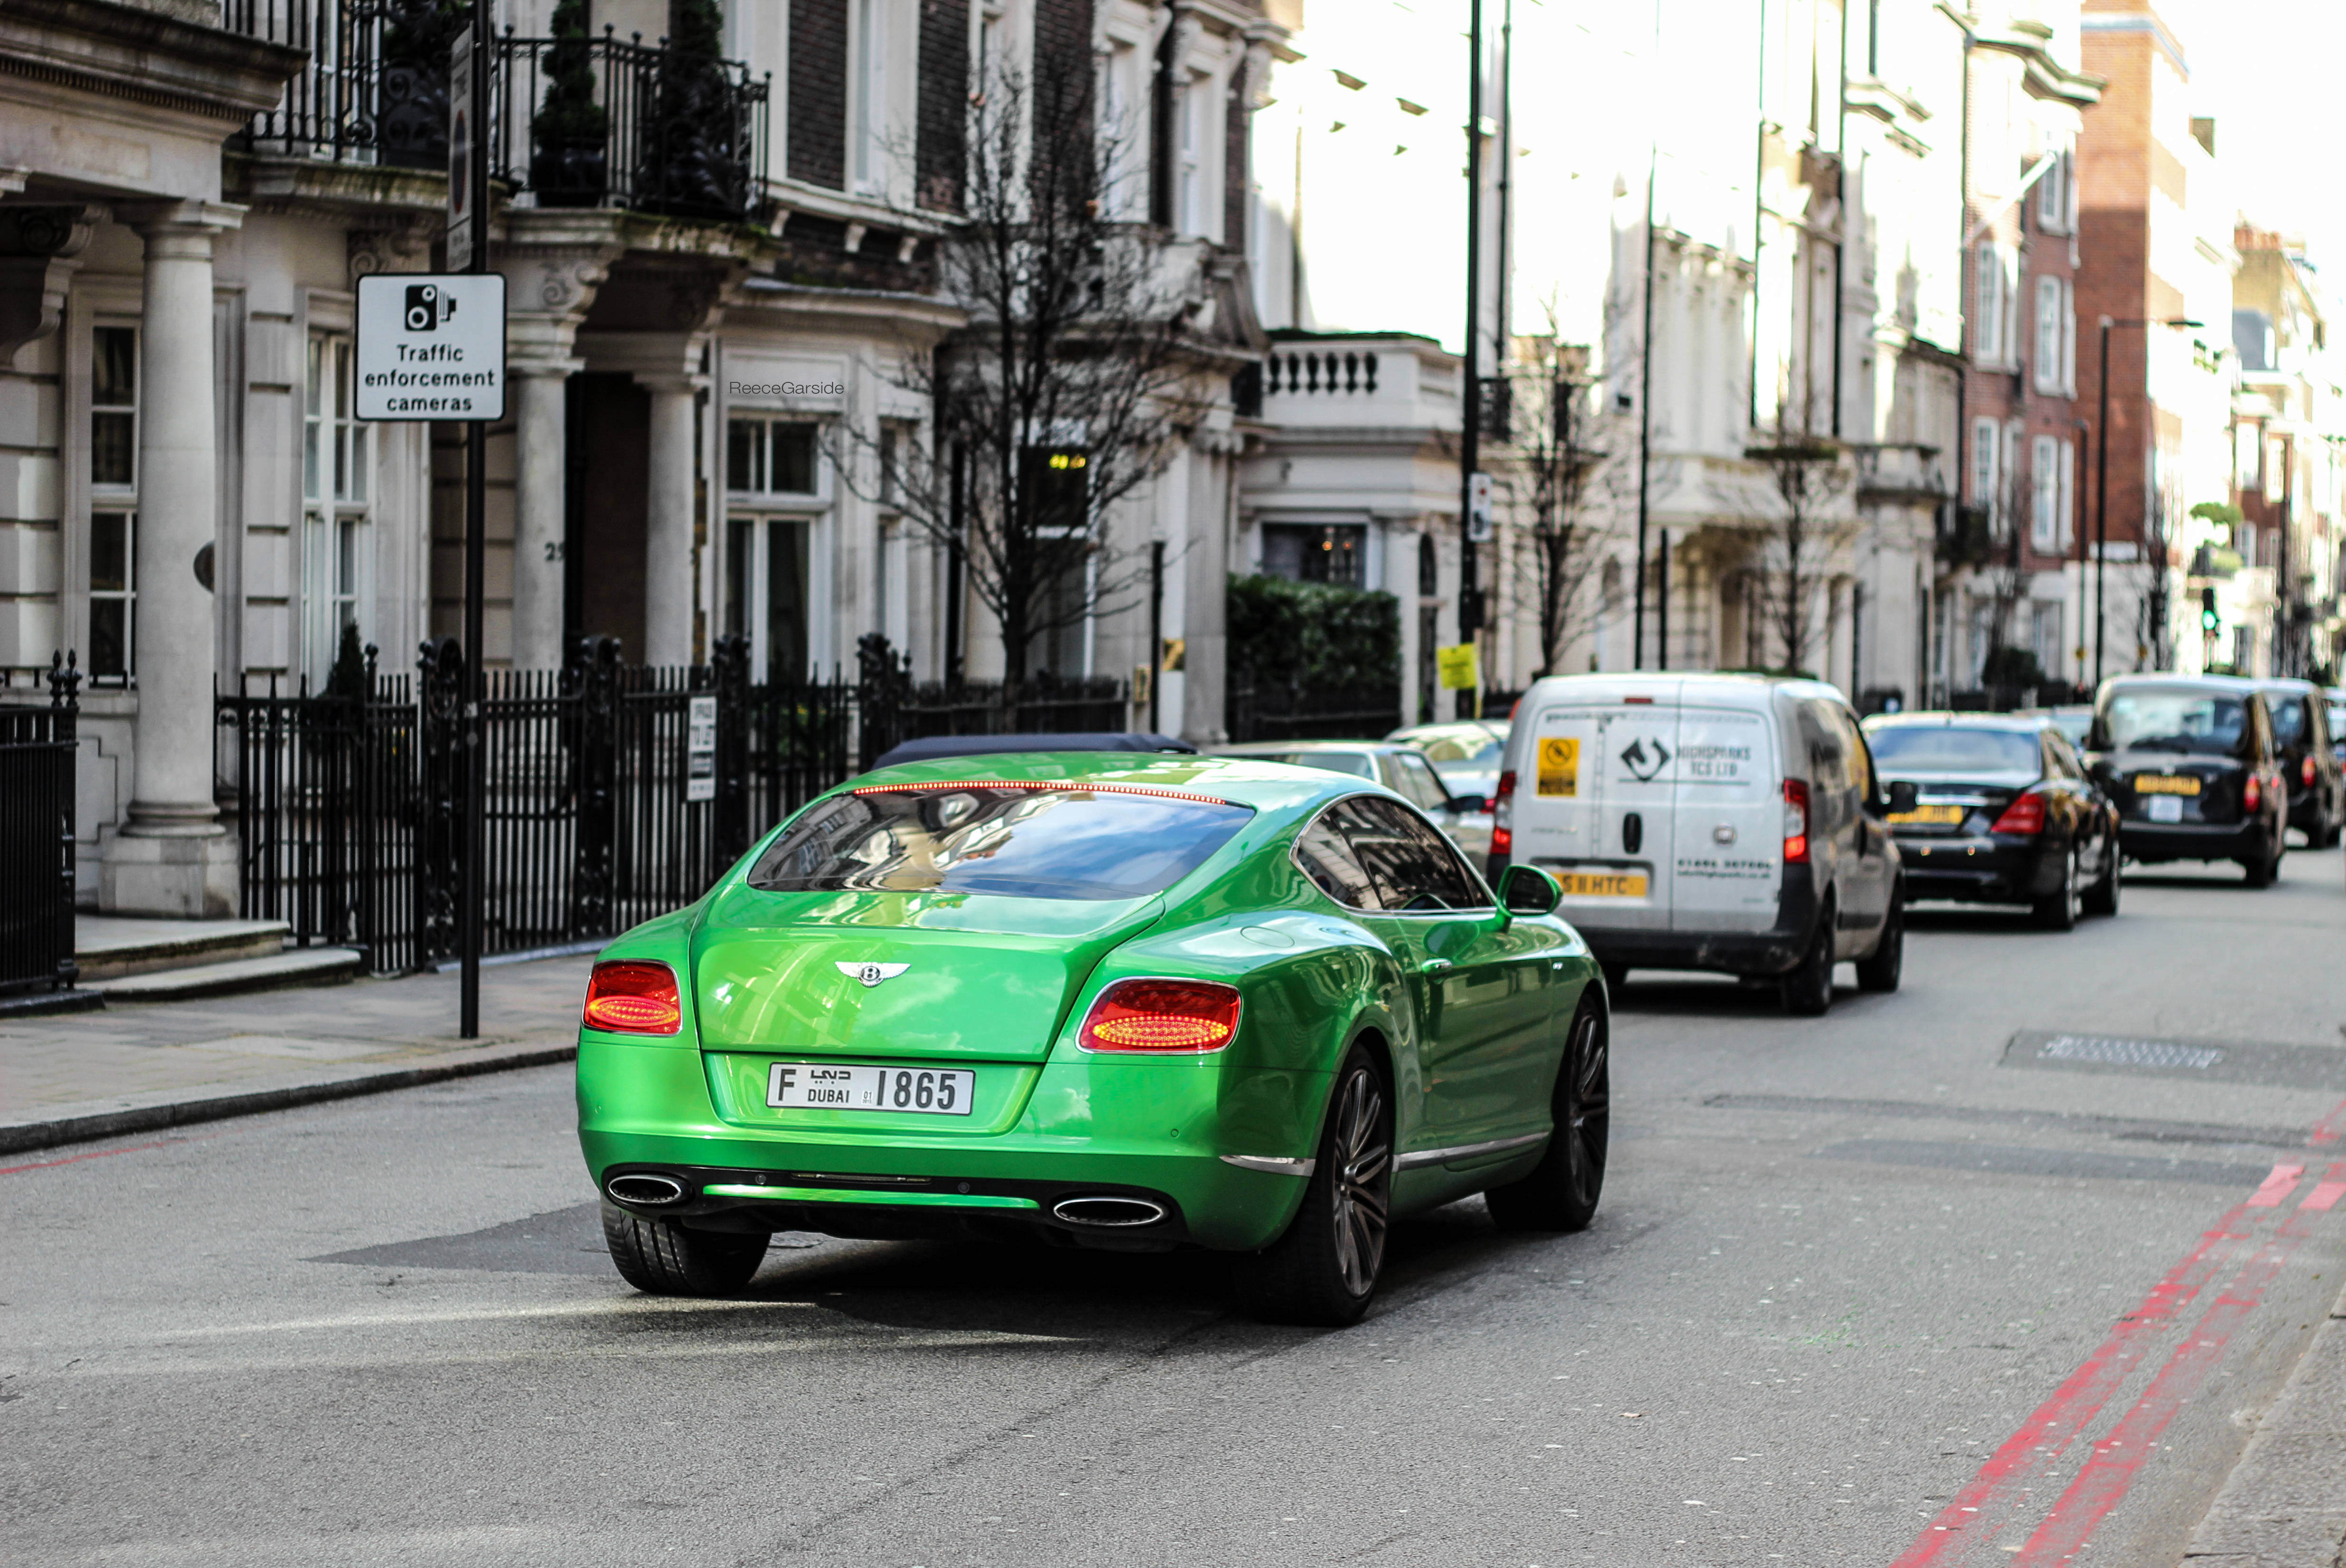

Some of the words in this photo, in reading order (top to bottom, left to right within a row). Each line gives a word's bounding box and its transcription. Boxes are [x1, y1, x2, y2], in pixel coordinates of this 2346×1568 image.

[397, 344, 463, 362] Traffic
[365, 369, 494, 387] enforcement
[387, 398, 472, 411] cameras
[778, 1069, 797, 1101] F
[810, 1070, 851, 1084] دبي
[808, 1089, 850, 1103] DUBAI
[863, 1091, 872, 1099] 01
[877, 1070, 956, 1110] 1865
